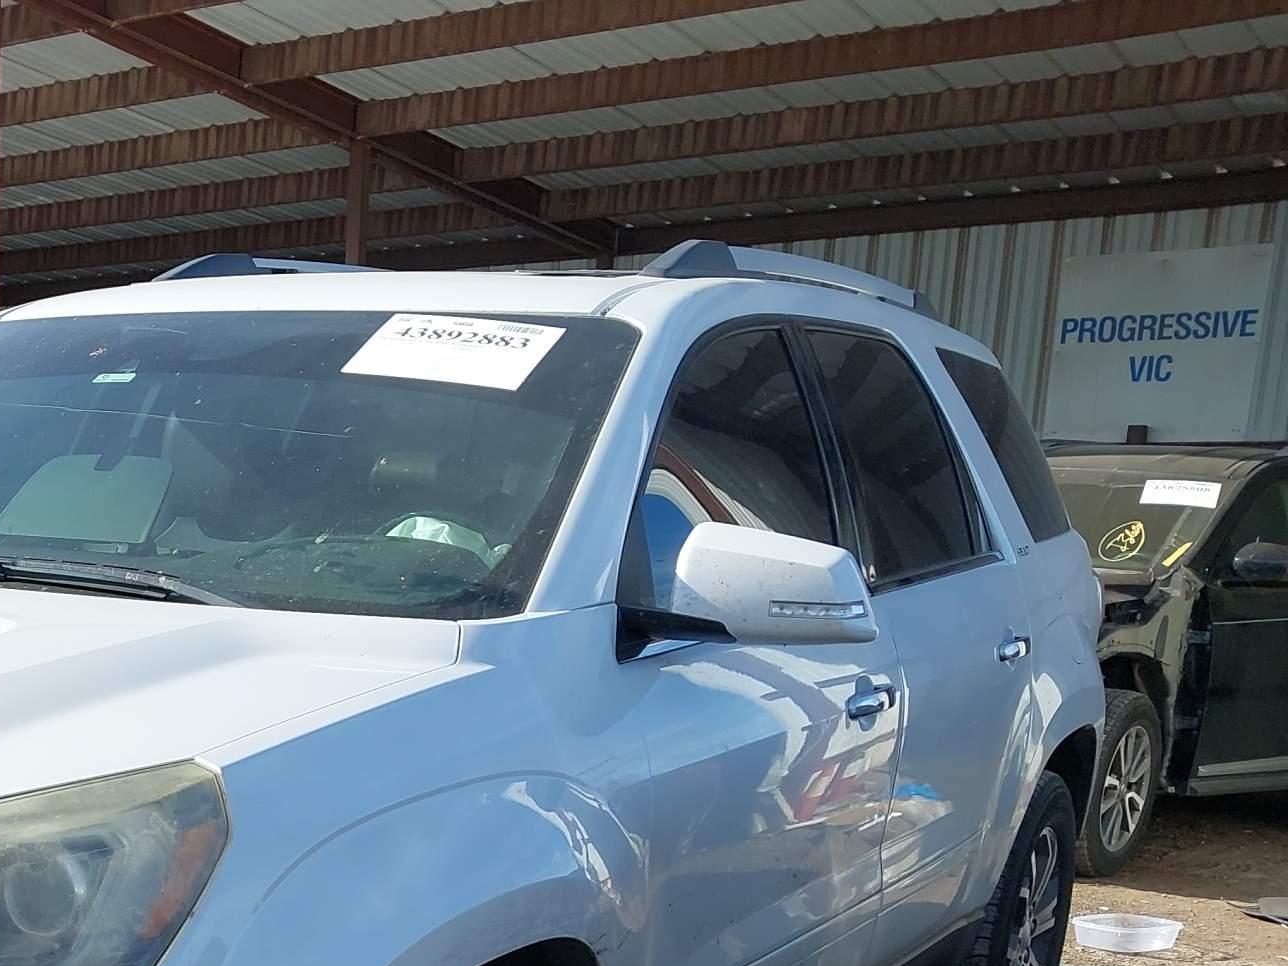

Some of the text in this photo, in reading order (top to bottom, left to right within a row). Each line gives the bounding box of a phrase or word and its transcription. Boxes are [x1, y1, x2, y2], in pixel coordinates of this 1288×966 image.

[394, 326, 531, 349] 43892883
[1060, 309, 1259, 344] PROGRESSIVE
[1129, 354, 1174, 382] VIC
